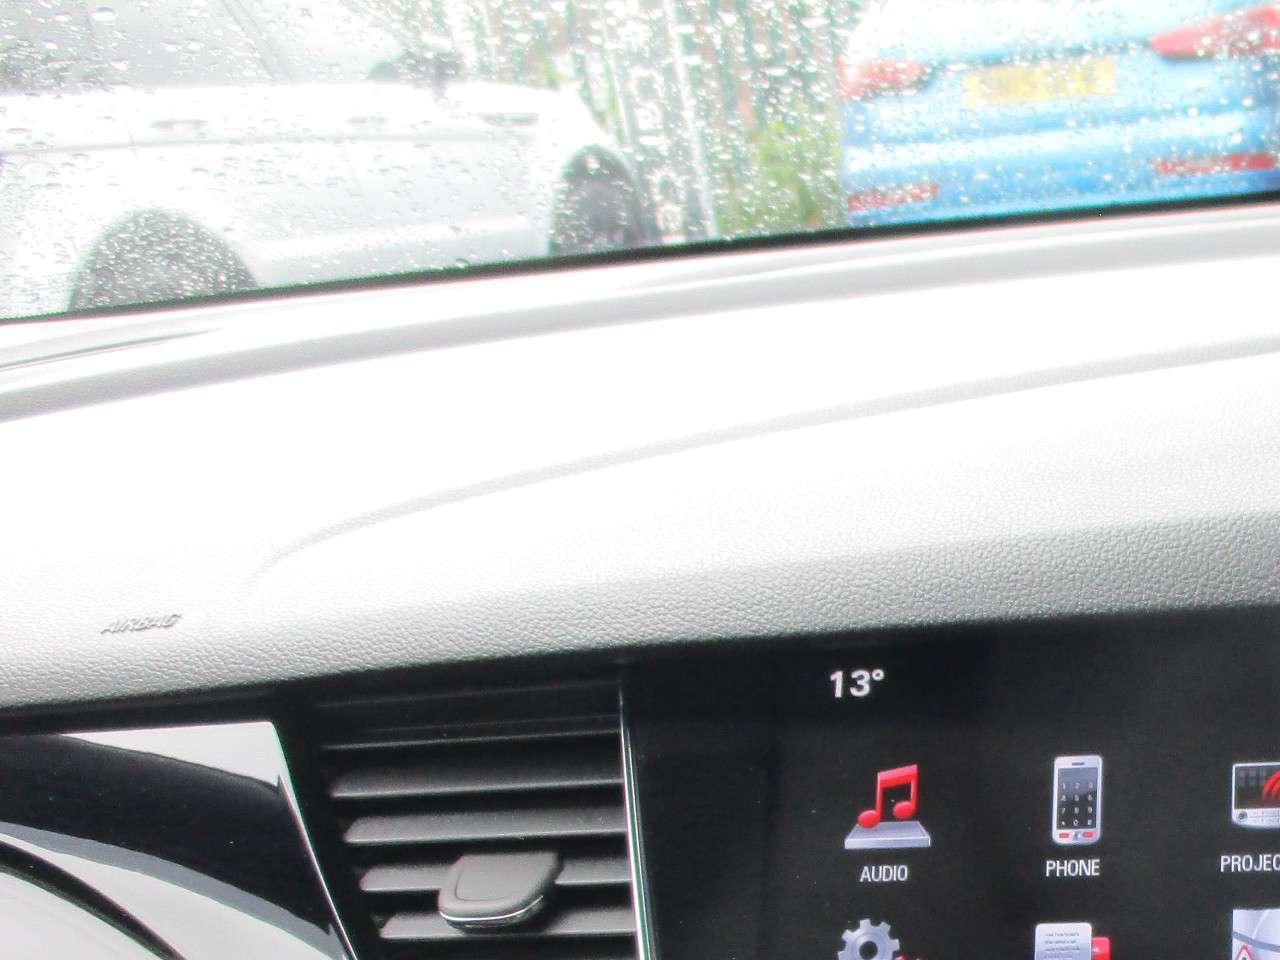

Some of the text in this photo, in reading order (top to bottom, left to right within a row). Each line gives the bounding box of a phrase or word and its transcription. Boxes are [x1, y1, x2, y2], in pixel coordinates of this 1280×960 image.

[829, 668, 885, 698] 13°
[859, 864, 909, 882] AUDIO
[1045, 858, 1101, 878] PHONE
